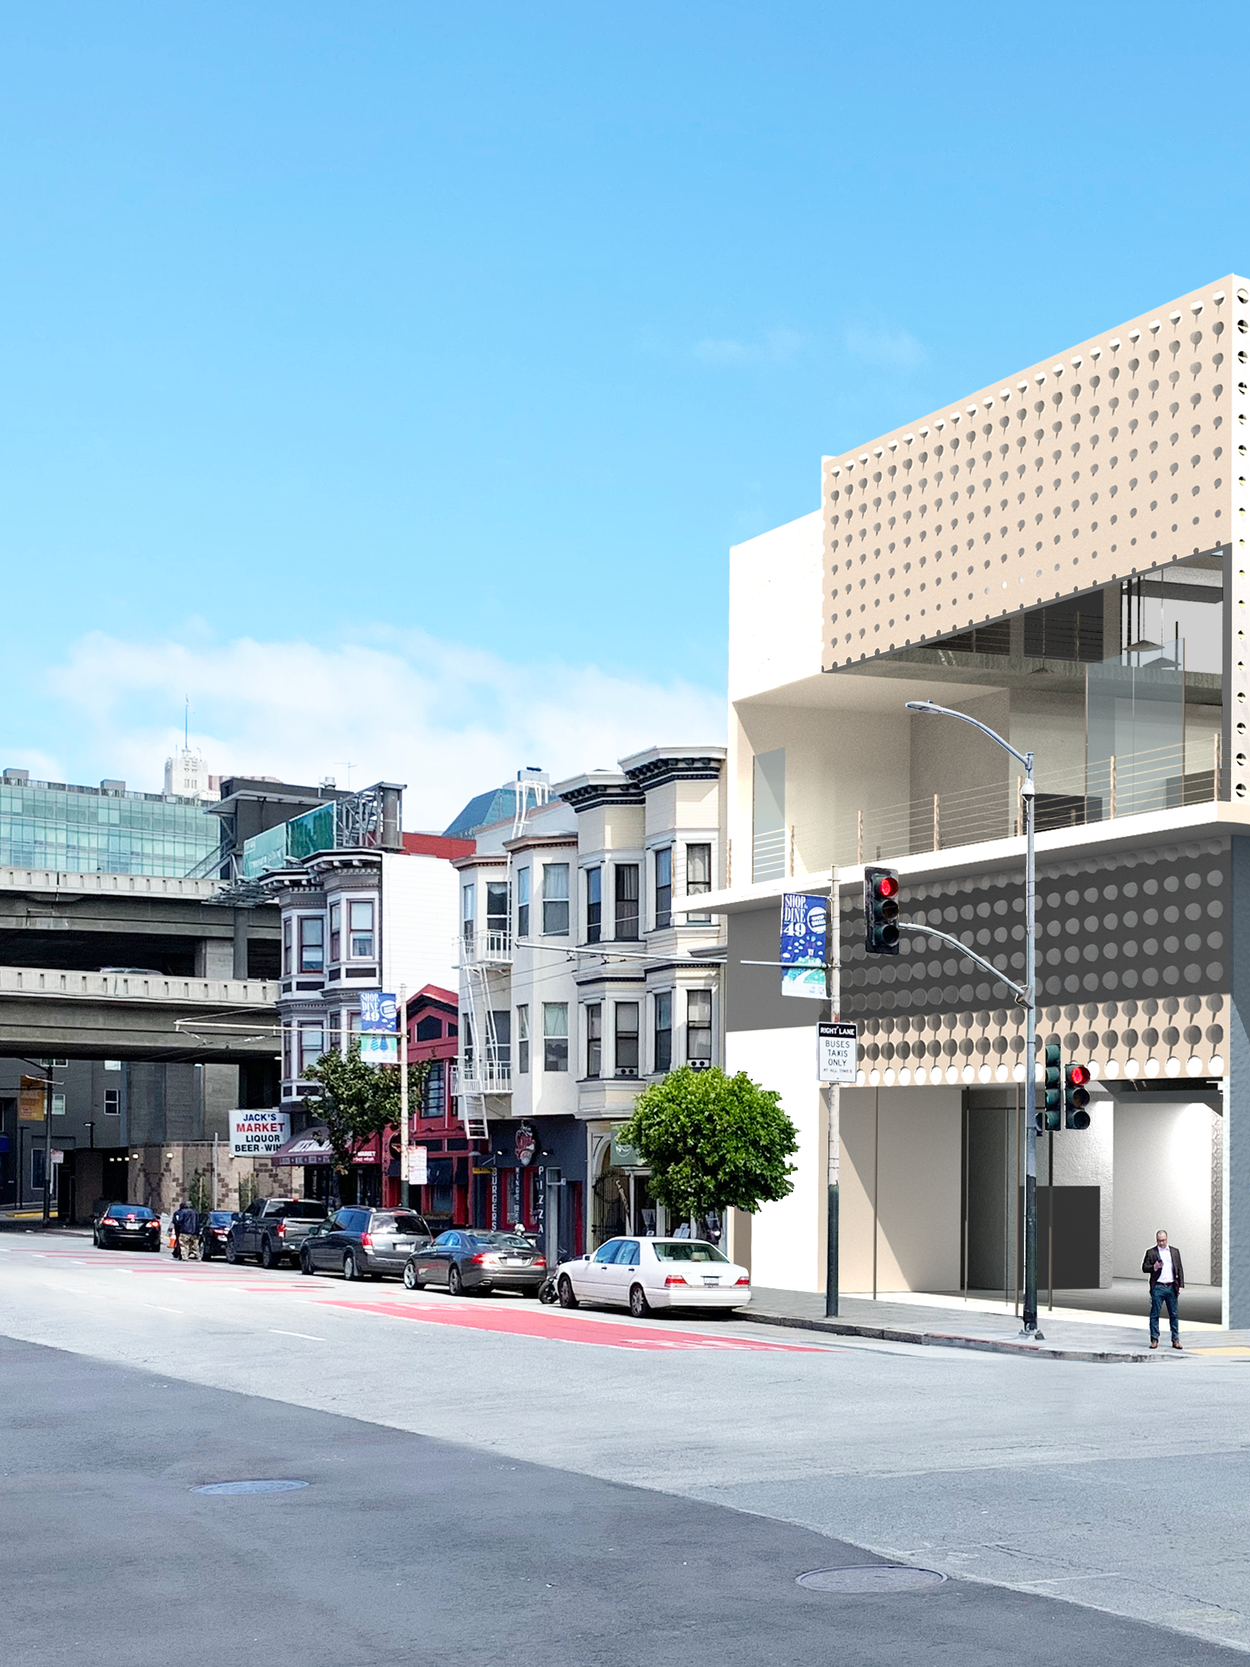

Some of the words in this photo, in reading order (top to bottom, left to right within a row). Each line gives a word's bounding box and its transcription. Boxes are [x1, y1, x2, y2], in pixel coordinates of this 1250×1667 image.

[784, 894, 806, 908] SHOP
[784, 907, 806, 923] DINE
[783, 922, 806, 937] 49
[362, 1012, 380, 1022] 49
[820, 1026, 837, 1035] RIGHT
[839, 1028, 855, 1036] LANE
[825, 1039, 850, 1049] BUSES
[828, 1049, 849, 1058] TAXIS
[828, 1058, 847, 1067] ONLY
[243, 1113, 277, 1122] JACK'S
[236, 1122, 286, 1133] MARKET
[245, 1134, 281, 1143] LIQUOR
